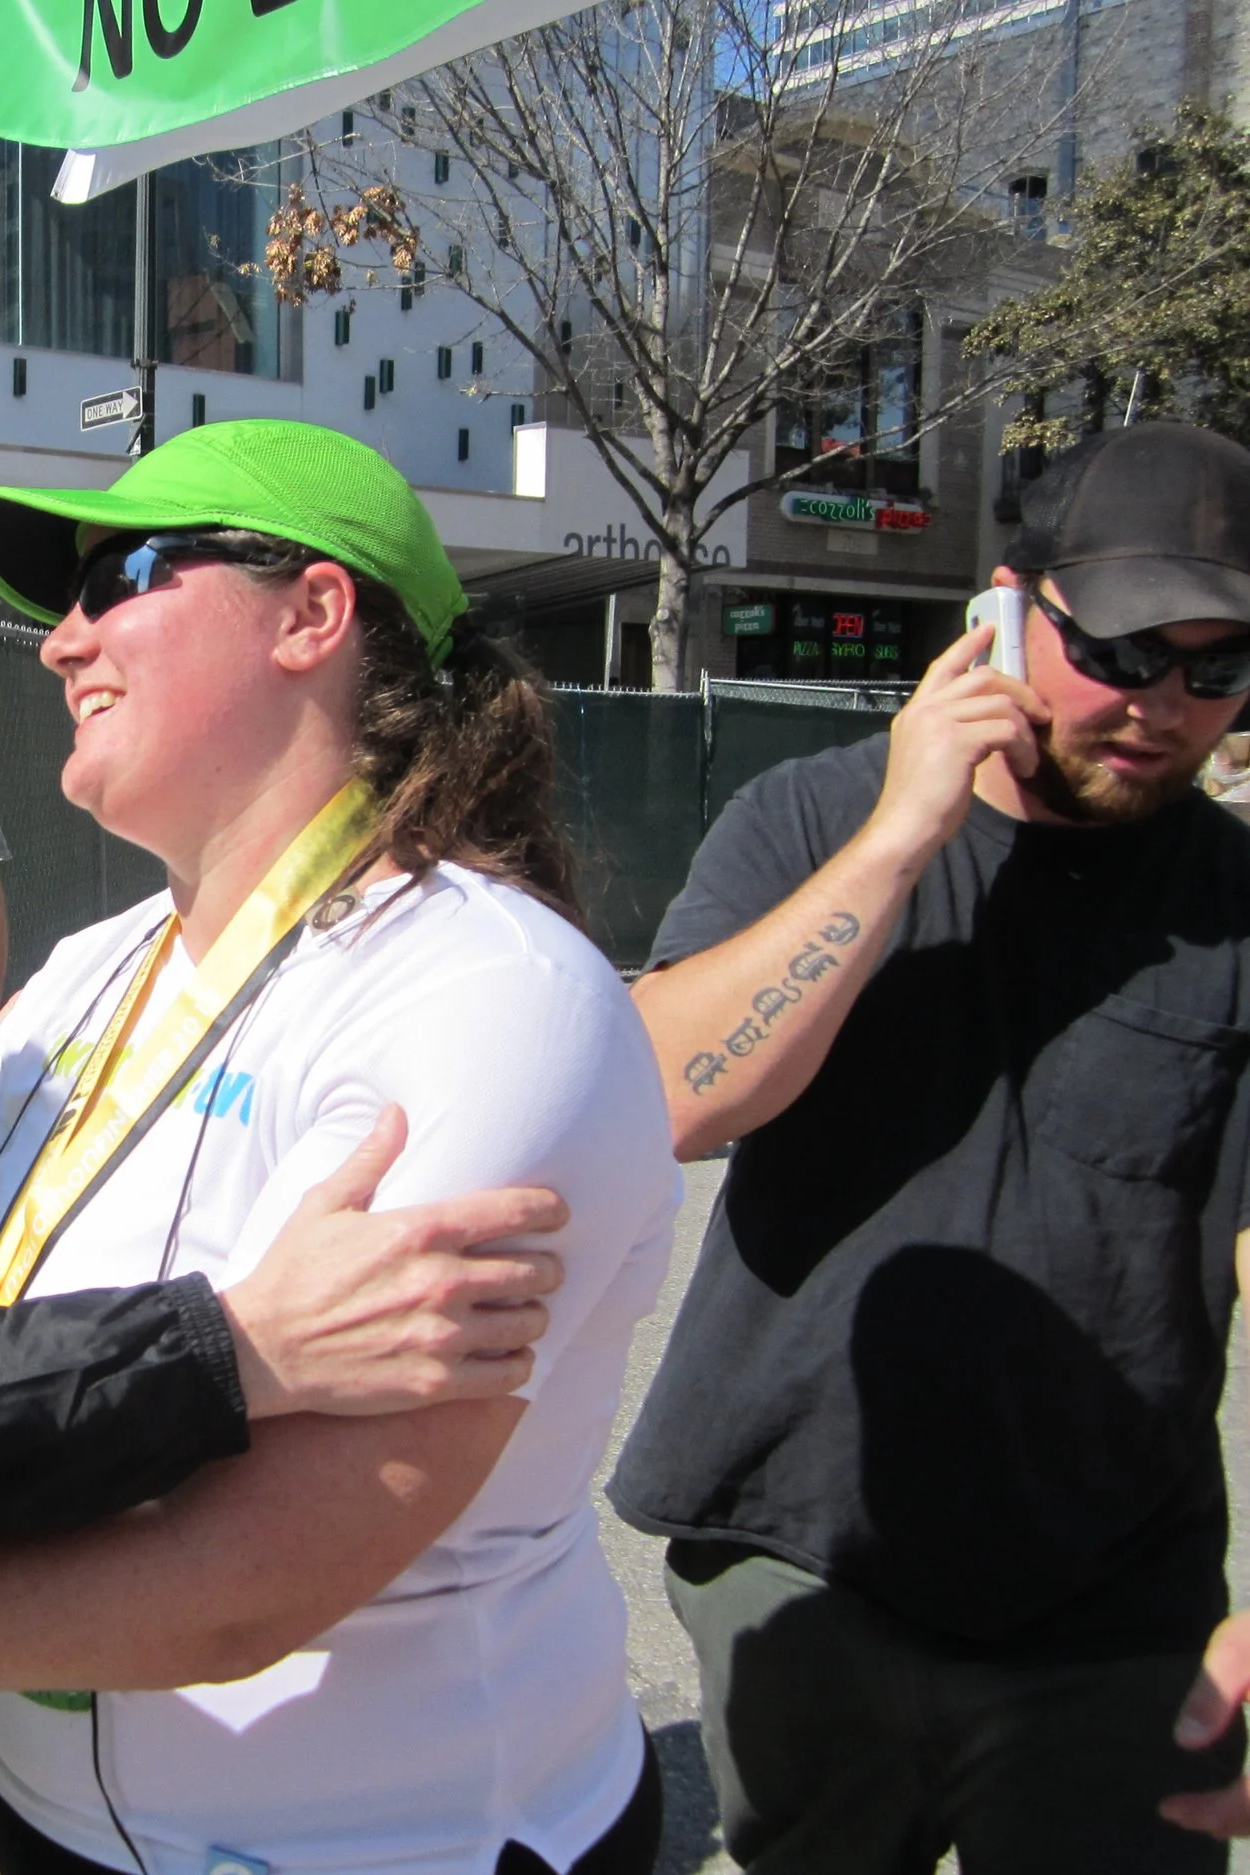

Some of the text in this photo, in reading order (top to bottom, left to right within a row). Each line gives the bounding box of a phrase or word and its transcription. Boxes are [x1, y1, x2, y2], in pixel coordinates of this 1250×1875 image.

[86, 400, 124, 420] ONE WAY
[734, 619, 760, 634] pizza
